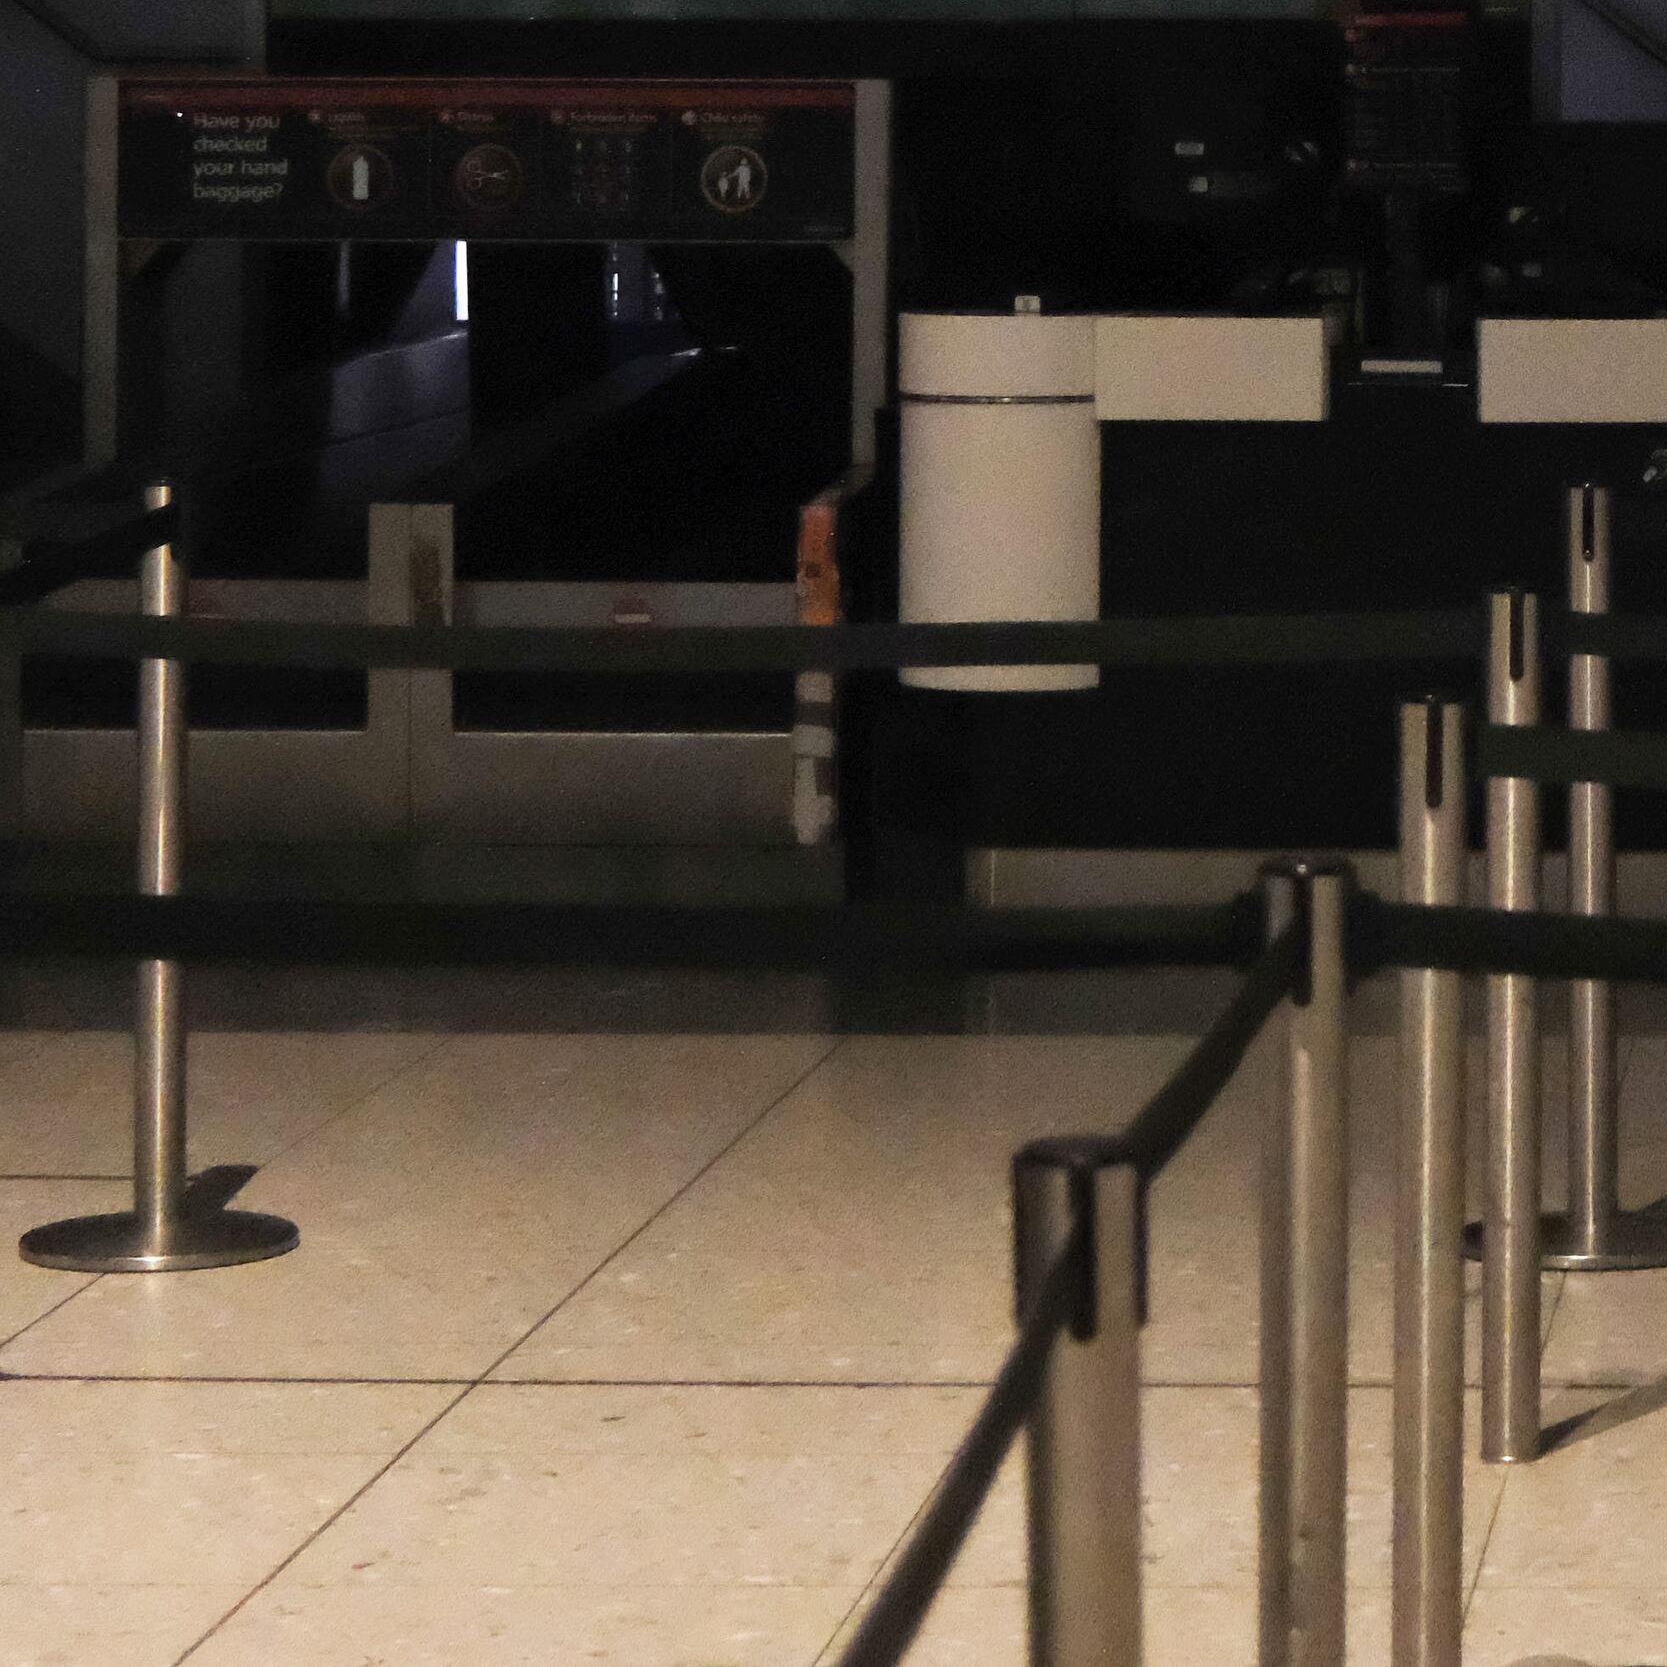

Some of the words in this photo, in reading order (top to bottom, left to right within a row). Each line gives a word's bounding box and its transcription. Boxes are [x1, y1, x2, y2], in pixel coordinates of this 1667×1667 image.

[193, 112, 240, 129] Have
[244, 116, 281, 133] you
[193, 135, 268, 153] checked
[193, 160, 235, 179] your
[240, 157, 288, 176] hand
